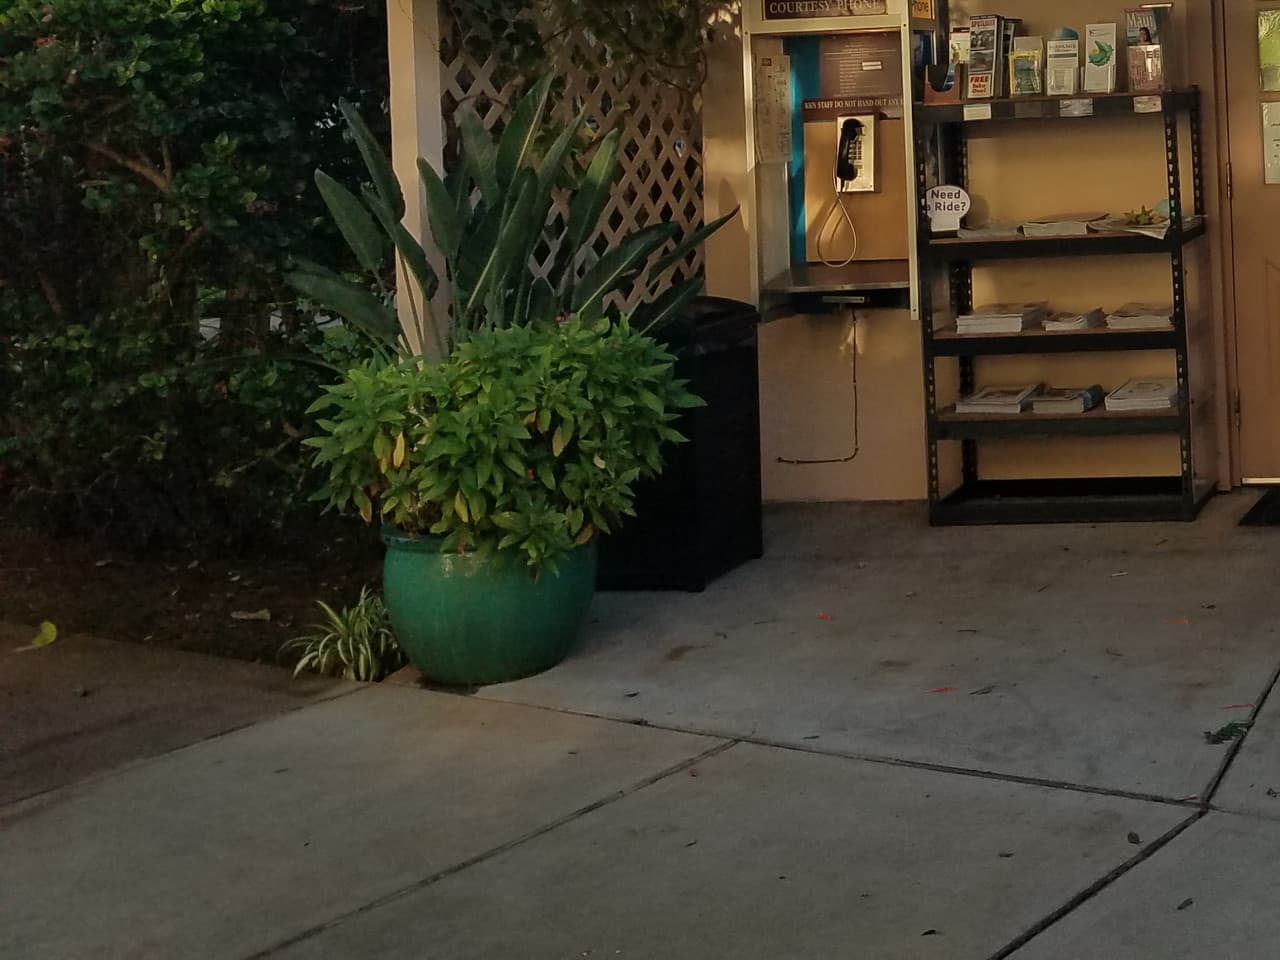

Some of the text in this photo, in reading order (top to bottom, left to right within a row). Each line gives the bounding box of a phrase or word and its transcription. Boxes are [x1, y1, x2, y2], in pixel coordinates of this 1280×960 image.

[769, 0, 832, 14] COURTESY
[818, 100, 834, 109] STAFF
[834, 100, 844, 108] DO
[844, 99, 856, 108] NOT
[857, 99, 874, 107] HAND
[874, 98, 887, 106] OUT
[888, 97, 899, 106] ANY
[931, 189, 961, 200] Need
[935, 201, 966, 211] Ride?
